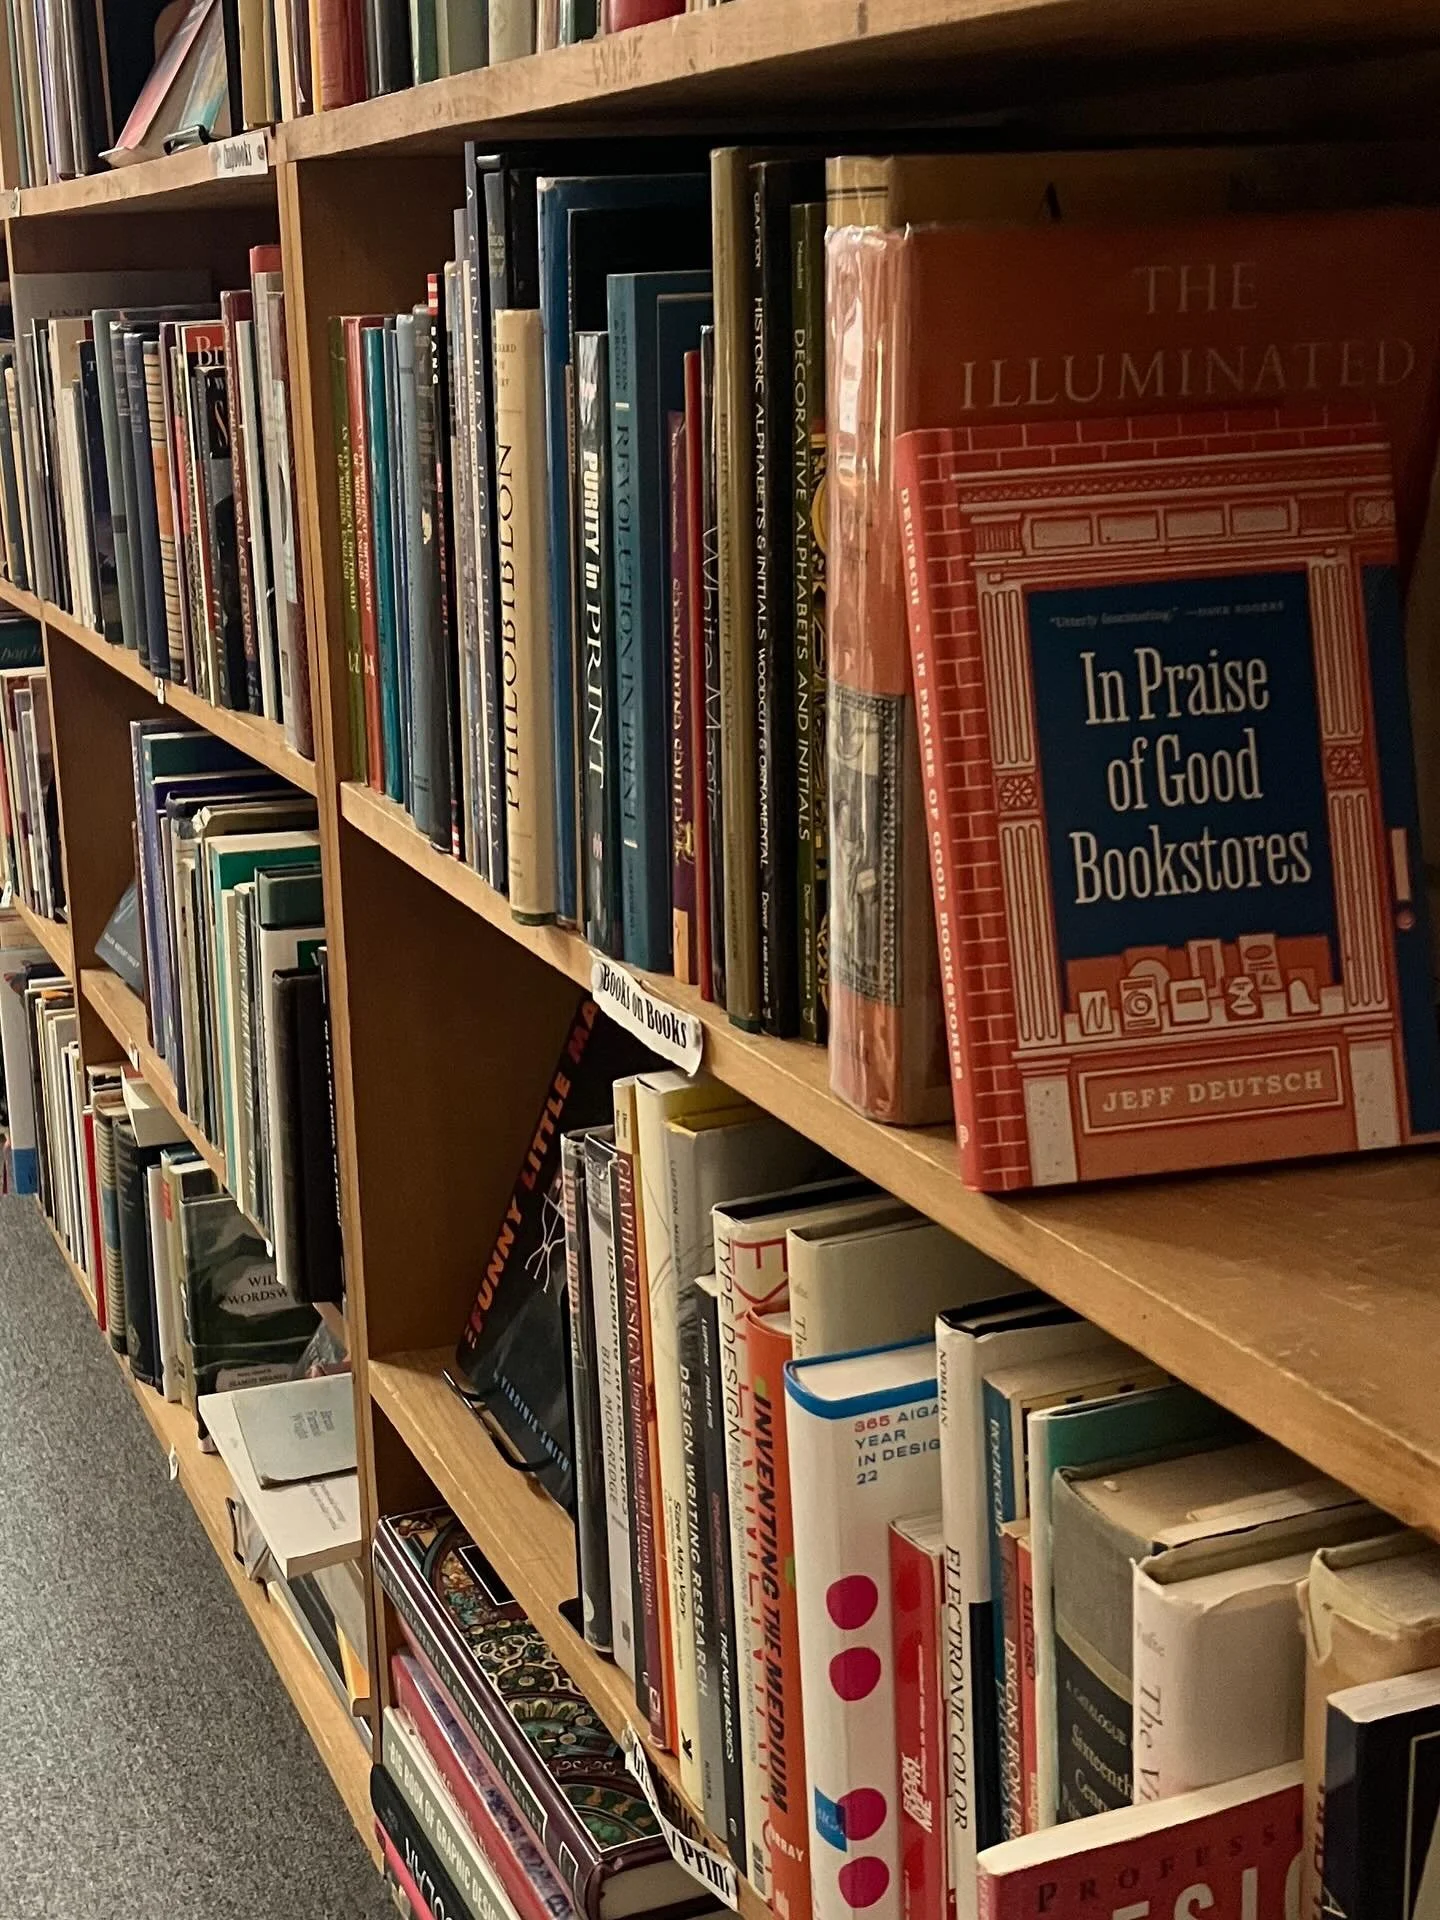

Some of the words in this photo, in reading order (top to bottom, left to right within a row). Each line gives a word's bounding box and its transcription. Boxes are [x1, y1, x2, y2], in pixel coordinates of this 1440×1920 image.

[753, 191, 763, 268] GRAFTON
[1145, 261, 1258, 315] THE
[754, 296, 766, 394] HISTORIC
[961, 342, 1416, 411] ILLUMINATED
[794, 327, 809, 502] DECORATIVE
[583, 450, 601, 556] PURITY
[756, 402, 768, 528] ALPHABETS
[233, 500, 247, 576] WALLACE
[240, 581, 253, 655] STEVENS
[584, 561, 601, 594] in
[615, 424, 636, 664] REVOLUTION
[795, 510, 811, 661] ALPHABETS
[901, 487, 920, 606] DEUTSCH
[498, 444, 521, 813] PHILOBIBLON
[757, 555, 768, 641] INITIALS
[585, 602, 605, 791] PRINT
[621, 672, 636, 707] IN
[758, 647, 768, 737] WOODCUT
[797, 669, 810, 731] AND
[915, 650, 928, 679] IN
[1080, 651, 1130, 727] In
[1136, 646, 1270, 720] Praise
[622, 720, 638, 823] PRINT
[919, 688, 936, 780] PRAISE
[1107, 736, 1150, 813] of
[1155, 727, 1264, 808] Good
[759, 754, 770, 869] ORNAMENTAL
[797, 738, 812, 842] INITIALS
[928, 788, 941, 821] OF
[933, 830, 948, 902] GOOD
[1069, 823, 1313, 906] Bookstores
[601, 963, 631, 1011] Books
[632, 991, 644, 1024] on
[645, 999, 688, 1049] Books
[939, 911, 965, 1080] BOOKSTORES
[1102, 1086, 1175, 1114] JEFF
[1189, 1069, 1325, 1104] DEUTSCH
[466, 1197, 525, 1336] FUNNY
[519, 1072, 570, 1193] LITTLE
[616, 1157, 640, 1269] GRAPHIC
[717, 1235, 736, 1315] TYPE
[600, 1343, 614, 1386] BILL
[625, 1280, 643, 1377] DESIGN:
[701, 1317, 711, 1366] LUPTON
[500, 1375, 542, 1433] VIRGINIA
[538, 1427, 572, 1472] SMITH
[680, 1365, 697, 1456] DESIGN
[721, 1320, 741, 1443] DESIGN
[853, 1414, 891, 1434] 365
[897, 1405, 940, 1427] AIGA
[604, 1395, 620, 1504] MOGGRIDGE
[629, 1380, 648, 1480] Inspirations
[856, 1430, 907, 1452] YEAR
[858, 1444, 877, 1467] IN
[881, 1437, 941, 1461] DESIG
[636, 1484, 650, 1518] and
[685, 1461, 702, 1564] WRITING
[753, 1392, 781, 1601] INVENTING
[855, 1469, 879, 1486] 22
[639, 1520, 656, 1617] Innovations
[690, 1568, 709, 1699] RESEARCH
[719, 1632, 731, 1663] THE
[763, 1604, 783, 1658] THE
[945, 1544, 967, 1732] ELECTRONIC
[720, 1664, 733, 1703] NEW
[1003, 1638, 1019, 1733] DESIGNS
[1138, 1683, 1162, 1751] The
[766, 1657, 789, 1815] MEDIUM
[1007, 1736, 1022, 1806] FROM
[951, 1734, 970, 1831] COLOR
[436, 1818, 472, 1891] GRAPHIC
[681, 1835, 731, 1899] Print
